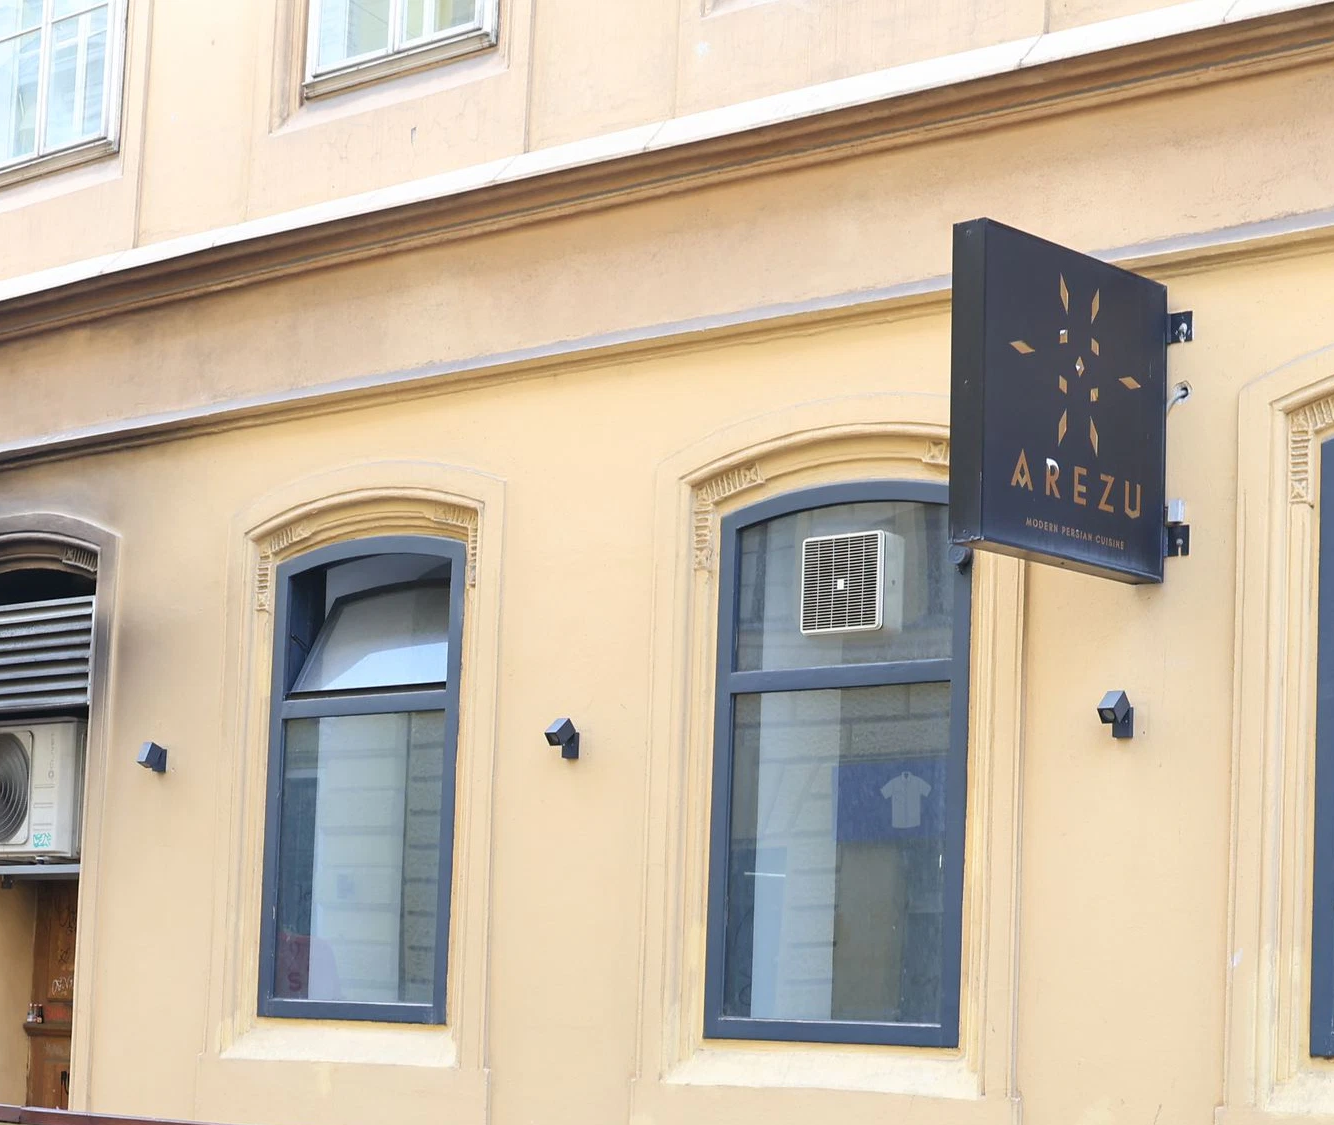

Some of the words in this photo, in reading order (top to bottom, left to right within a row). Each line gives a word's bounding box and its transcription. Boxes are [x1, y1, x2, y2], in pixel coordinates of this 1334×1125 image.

[1011, 448, 1142, 519] AREZU
[1026, 517, 1058, 533] MODERN
[1061, 526, 1093, 541] PERSIAN
[1095, 534, 1124, 549] CUISINE
